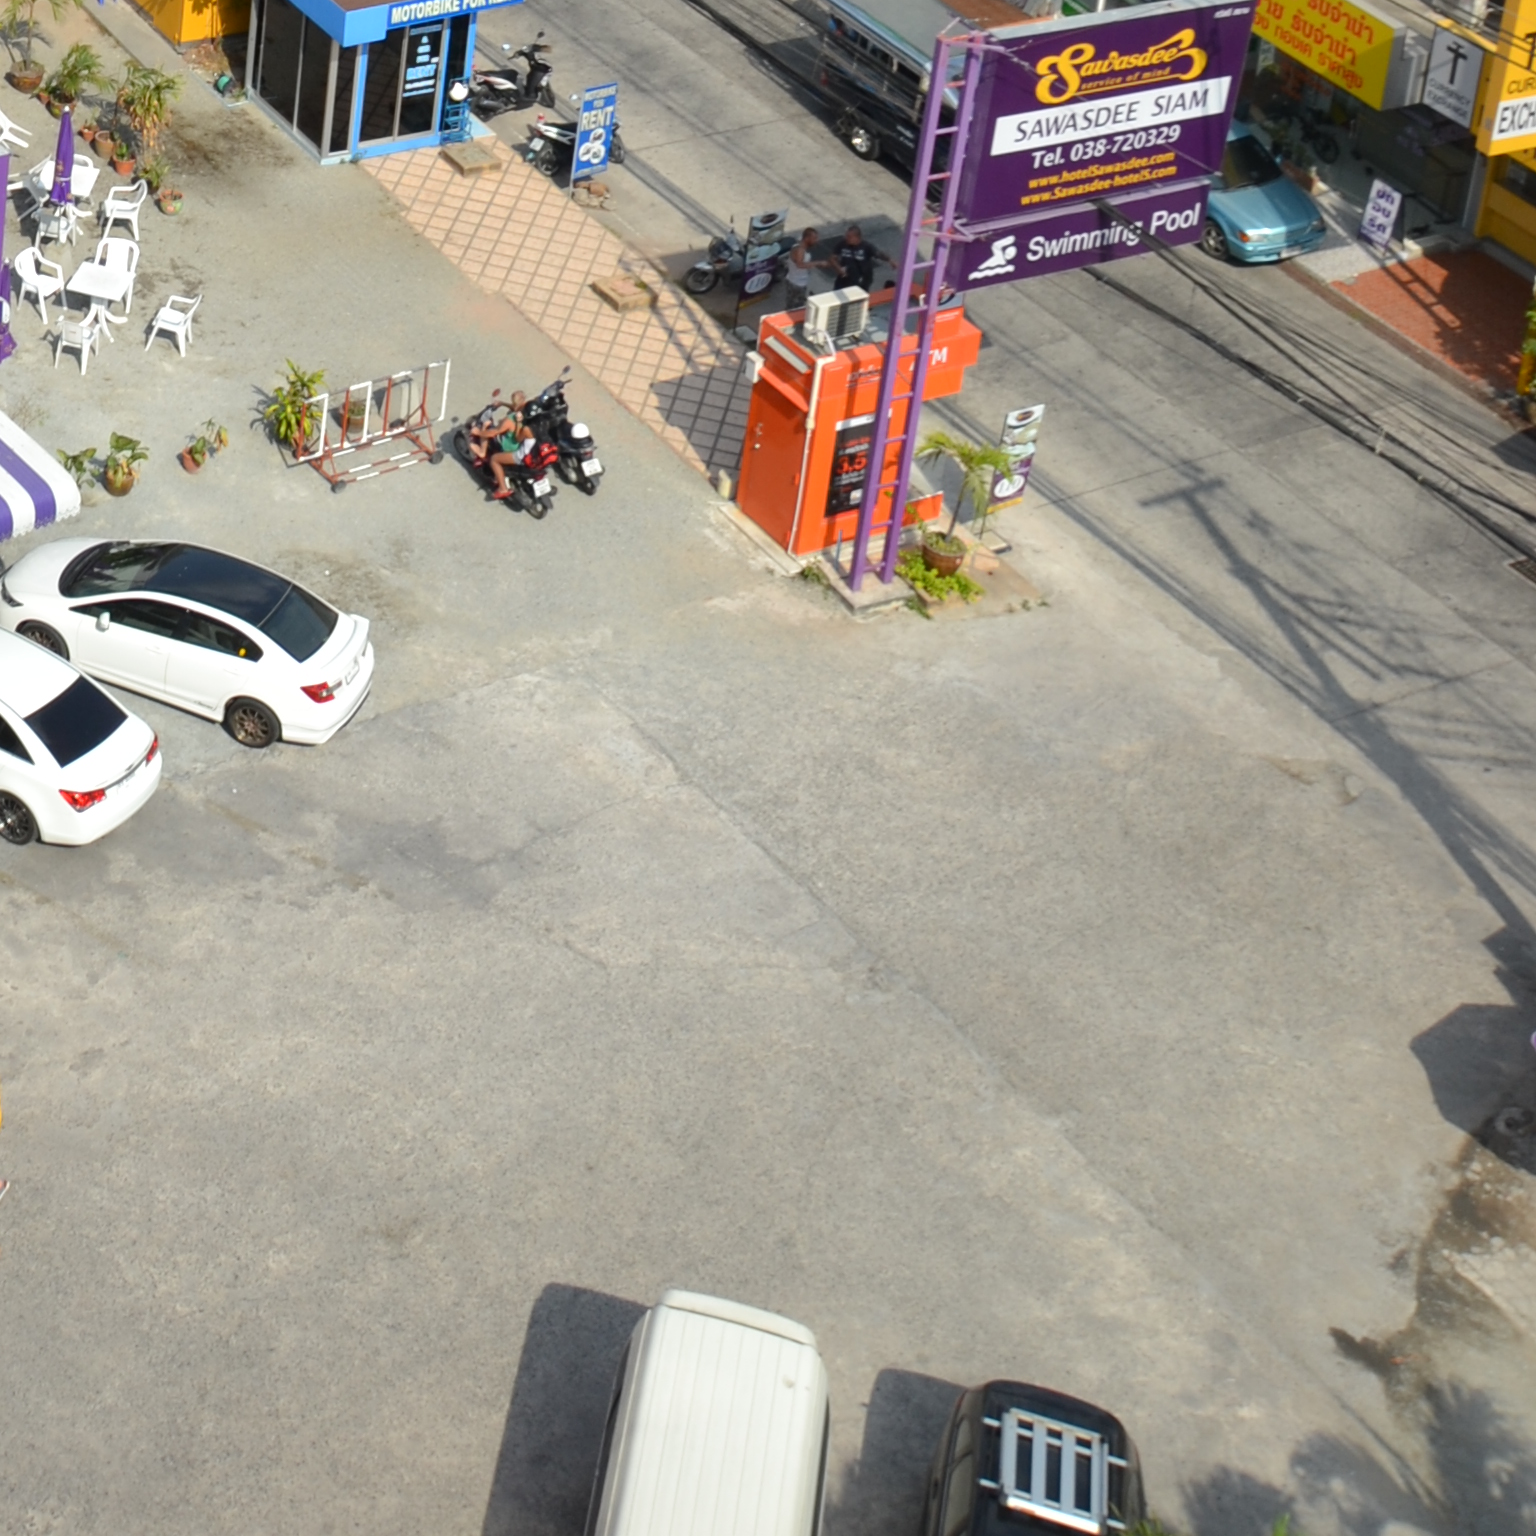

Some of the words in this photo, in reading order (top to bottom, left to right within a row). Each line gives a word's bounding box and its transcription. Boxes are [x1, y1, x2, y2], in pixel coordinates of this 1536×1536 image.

[1291, 8, 1356, 67] รับจำนำ
[1035, 28, 1208, 104] Sawasdee
[1080, 72, 1122, 91] service
[1125, 70, 1139, 84] of
[1140, 66, 1171, 81] mind
[581, 105, 615, 131] RENT
[1014, 100, 1140, 143] SAWASDEE
[1150, 87, 1210, 117] SIAM
[1031, 146, 1065, 169] Tel.
[1069, 124, 1181, 162] 038-720329
[1026, 220, 1144, 262] Swimming
[1149, 202, 1202, 236] Pool
